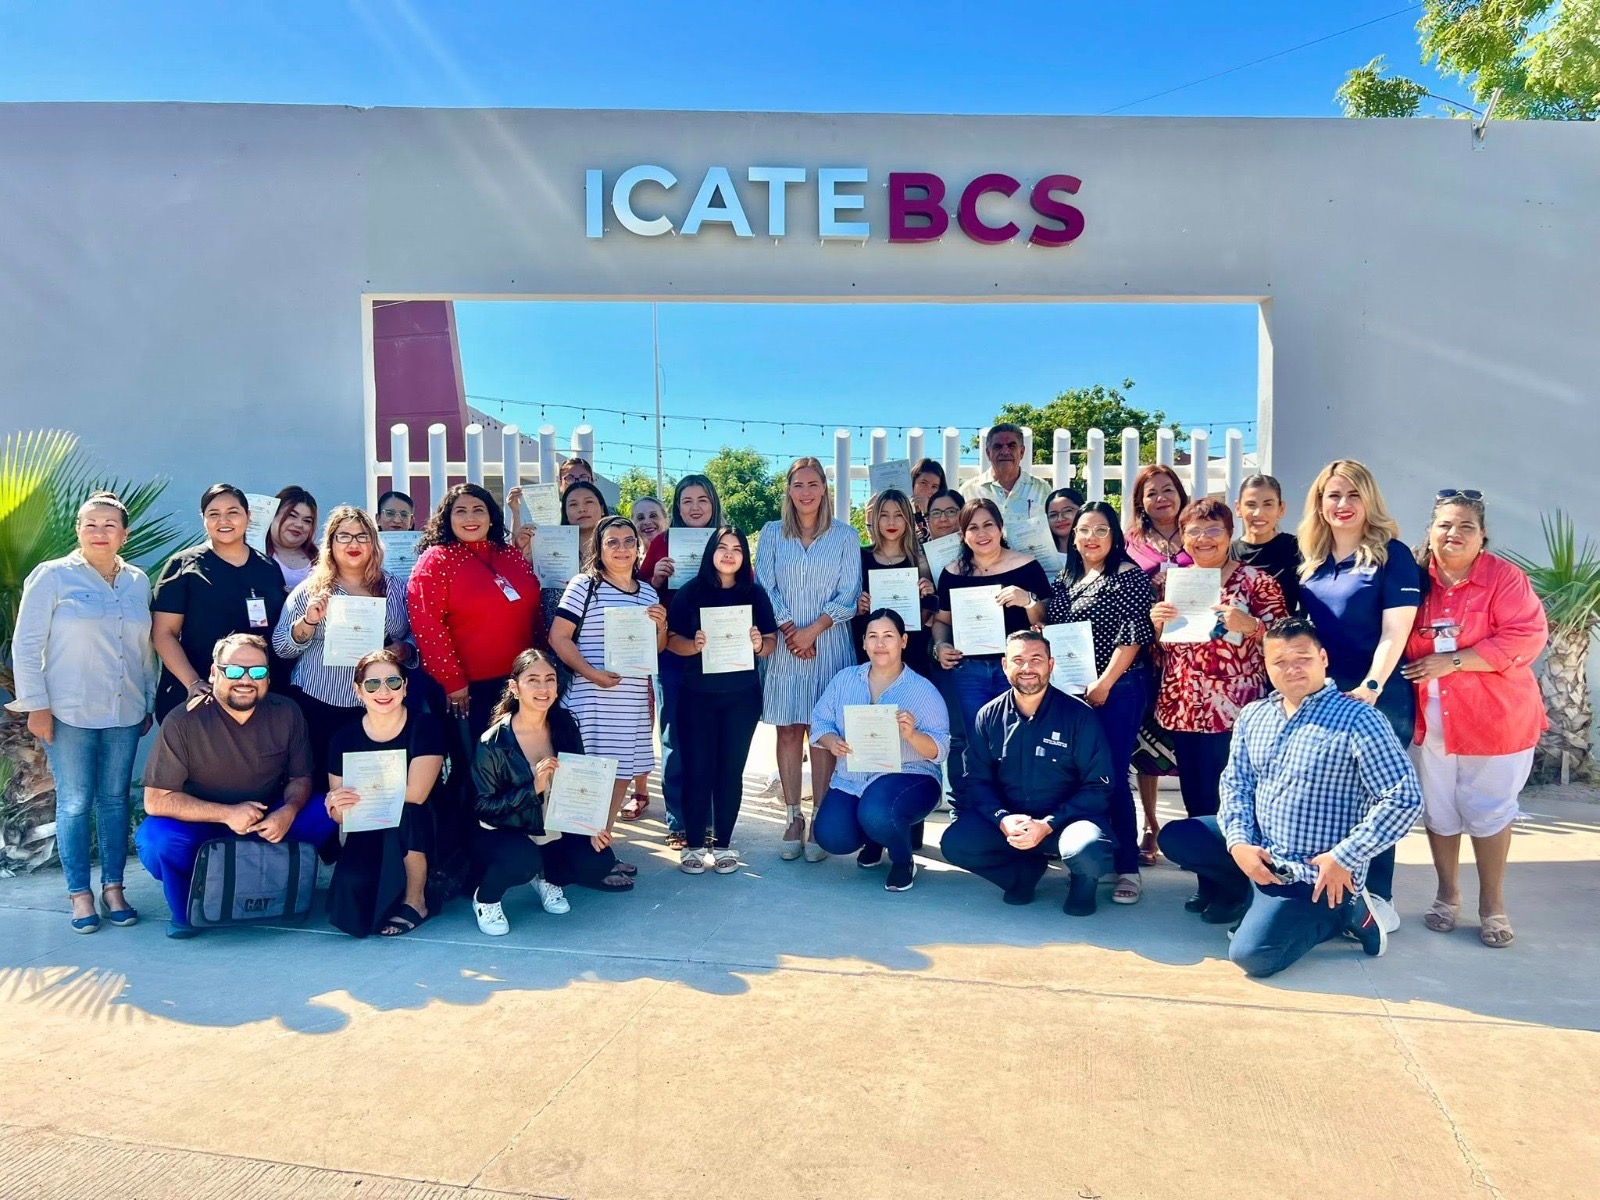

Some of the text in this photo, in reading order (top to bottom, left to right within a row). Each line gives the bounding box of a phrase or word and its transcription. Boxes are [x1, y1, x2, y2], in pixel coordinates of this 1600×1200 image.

[585, 164, 1085, 247] ICATE BCS
[244, 897, 271, 913] CAT
